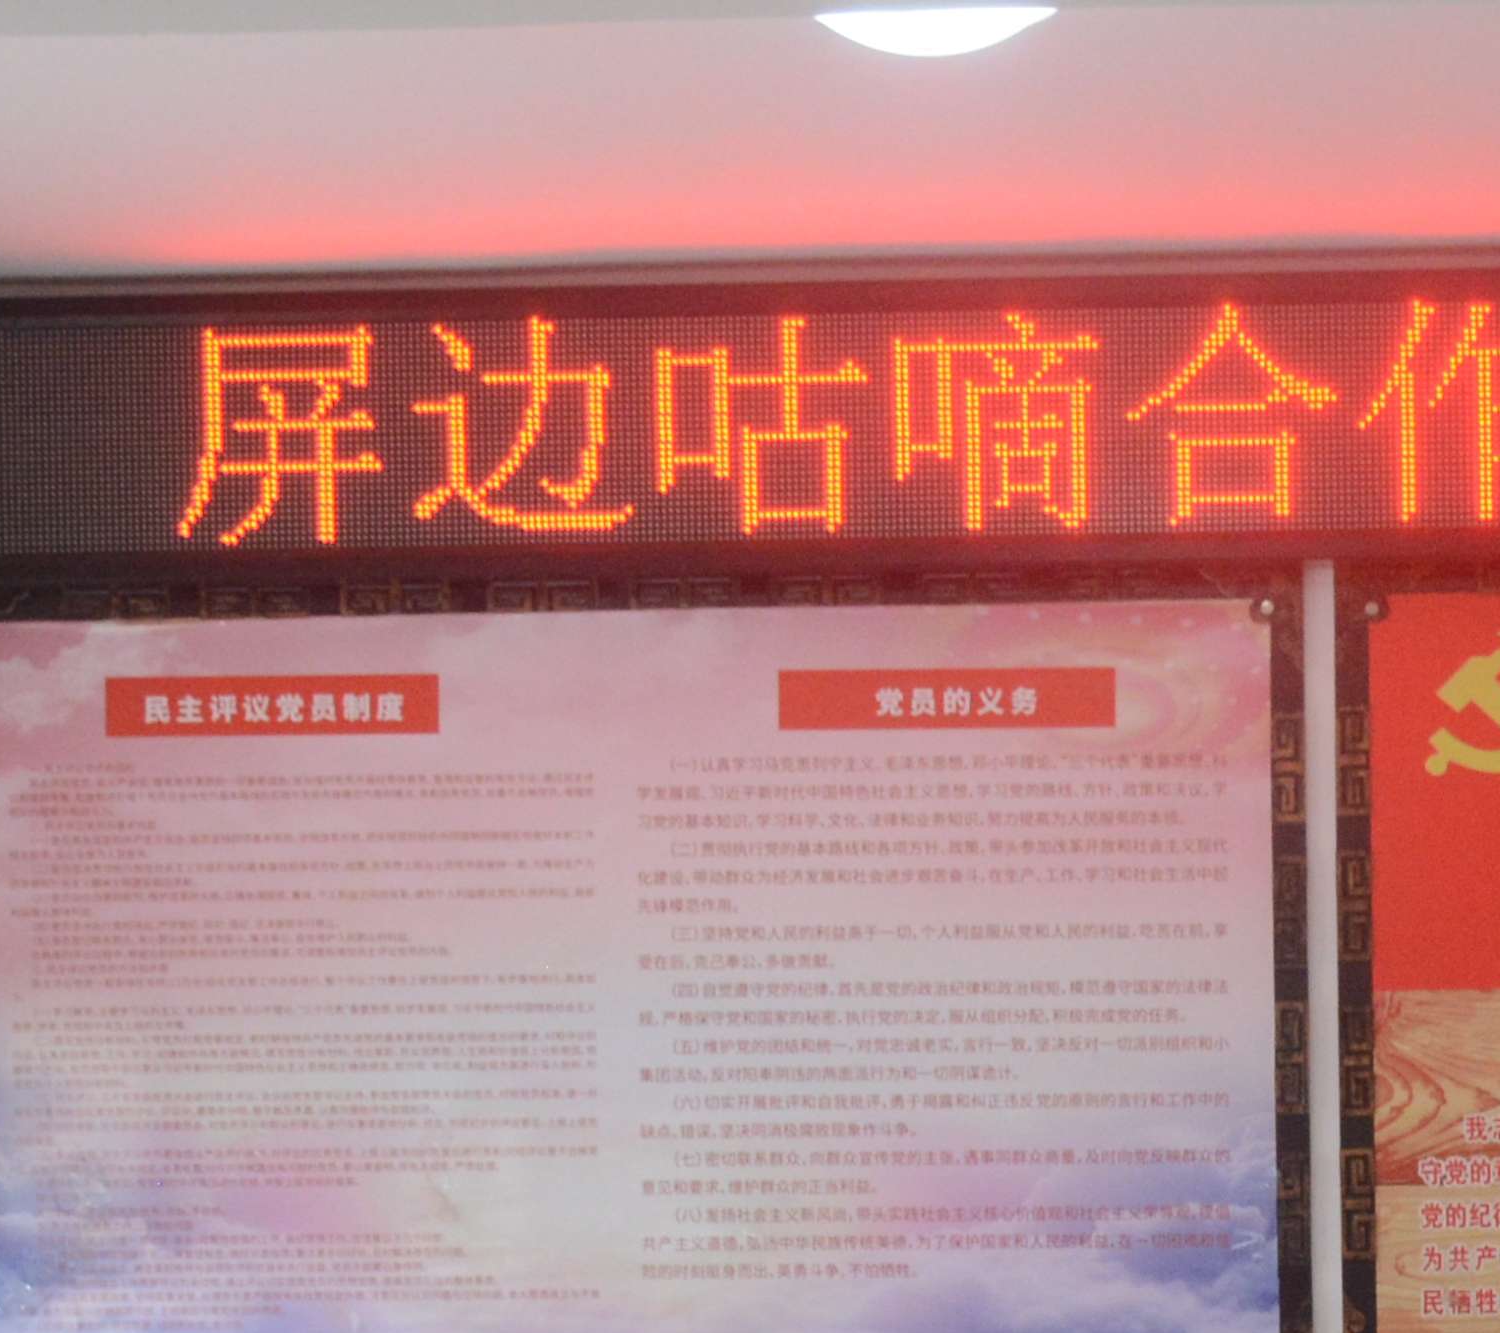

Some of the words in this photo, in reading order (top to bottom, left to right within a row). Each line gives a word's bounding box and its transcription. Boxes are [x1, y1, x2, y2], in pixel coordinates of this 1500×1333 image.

[143, 690, 405, 724] 民主评议党员制度
[874, 684, 1042, 718] 党员的义务
